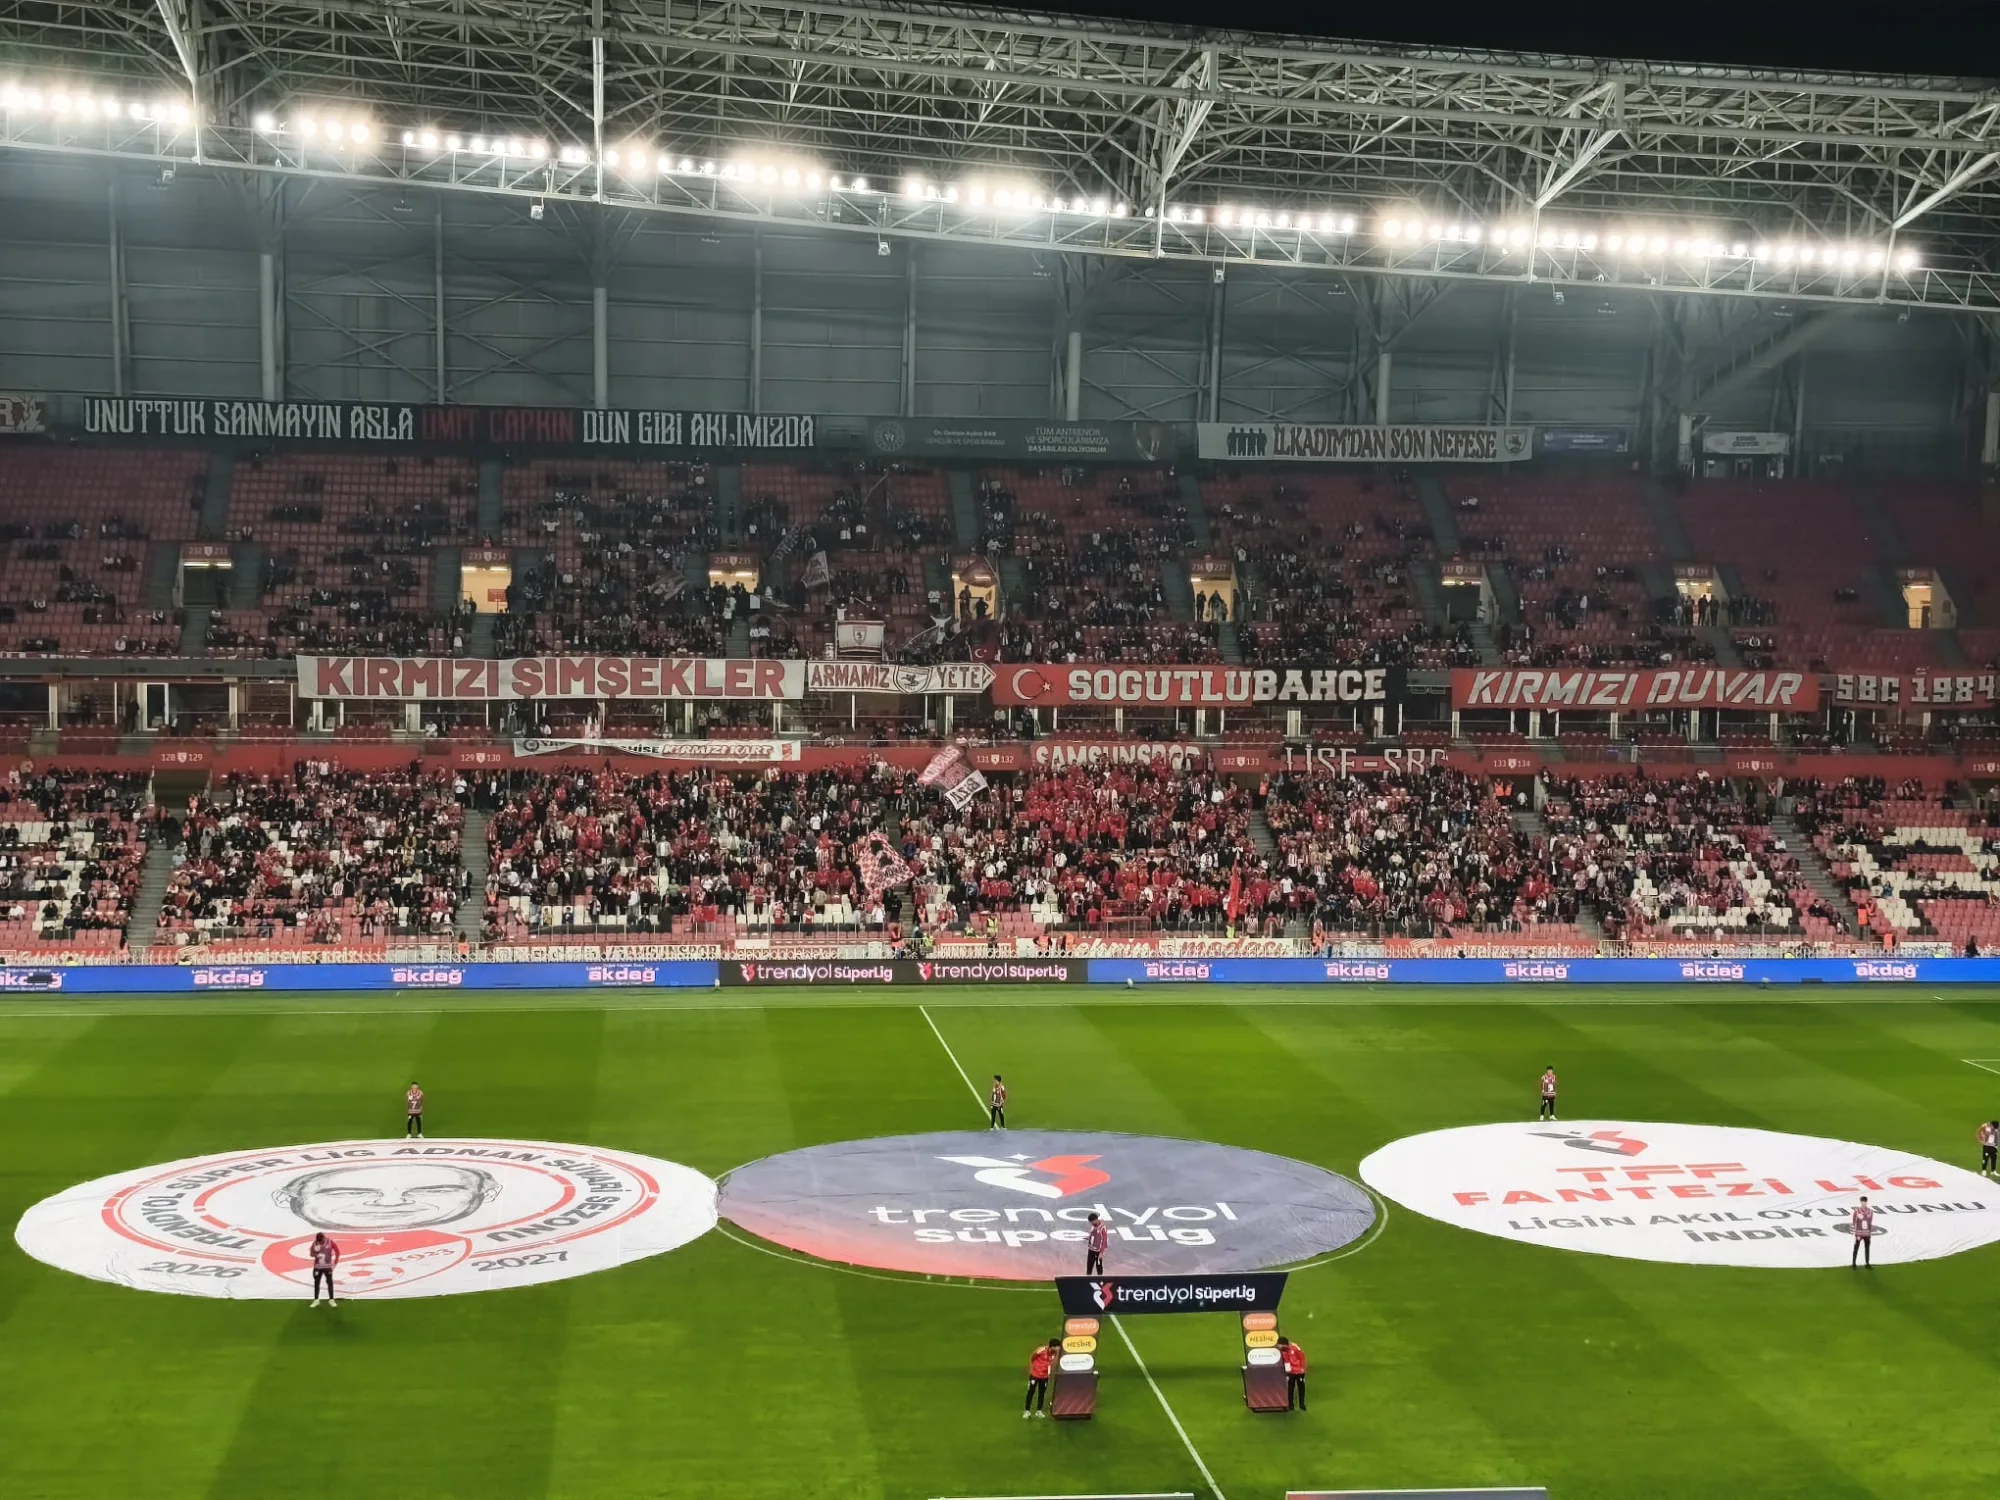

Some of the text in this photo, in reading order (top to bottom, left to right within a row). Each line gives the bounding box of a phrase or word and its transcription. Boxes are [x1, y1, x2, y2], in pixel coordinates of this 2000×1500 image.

[85, 398, 206, 434] UNUTTUK
[214, 402, 342, 438] SANMAYIN
[350, 406, 414, 440] ASLA
[583, 411, 630, 443] DÜN
[638, 411, 683, 445] GİBİ
[690, 414, 815, 447] AKLIMIZDA
[1025, 436, 1037, 444] VE
[1391, 428, 1426, 459] SON
[1430, 430, 1497, 459] NEFESE
[317, 657, 500, 697] KIRMIZI
[810, 664, 890, 688] ARMAMIZ
[1068, 667, 1387, 702] SOGUTLUBAHCE
[1467, 669, 1804, 706] KIRMIZI DUVAR
[1837, 674, 1997, 704] SBC 1984
[160, 753, 204, 762] 128 129
[460, 753, 501, 762] 129 130
[729, 744, 773, 756] KART
[976, 755, 1014, 763] 131 132
[1222, 757, 1260, 766] 132 133
[1493, 759, 1530, 768] 133 134
[1736, 761, 1750, 770] 134
[193, 970, 264, 986] akdağ
[393, 967, 462, 985] akdağ
[588, 966, 656, 983] akdağ
[757, 964, 833, 983] trendyol
[934, 962, 1008, 981] trendyol
[1146, 963, 1210, 979] akdağ
[1326, 963, 1389, 979] akdağ
[1505, 963, 1569, 979] akdağ
[1682, 963, 1744, 979] akdağ
[1855, 963, 1917, 979] akdağ
[1555, 1162, 1747, 1183] TFF
[140, 1147, 633, 1250] TRENDYOL SÜPER LİG ADNAN SÜVARİ SEZONU
[1452, 1174, 1944, 1206] FANTEZİ LİG
[867, 1203, 1238, 1227] trendyol
[1507, 1215, 1637, 1230] LİGİN
[1649, 1211, 1753, 1225] AKIL
[913, 1225, 1217, 1248] süpeLig
[1682, 1224, 1829, 1243] İNDİR
[138, 1246, 571, 1280] 2026 1923 2027
[1117, 1284, 1193, 1304] trendyol
